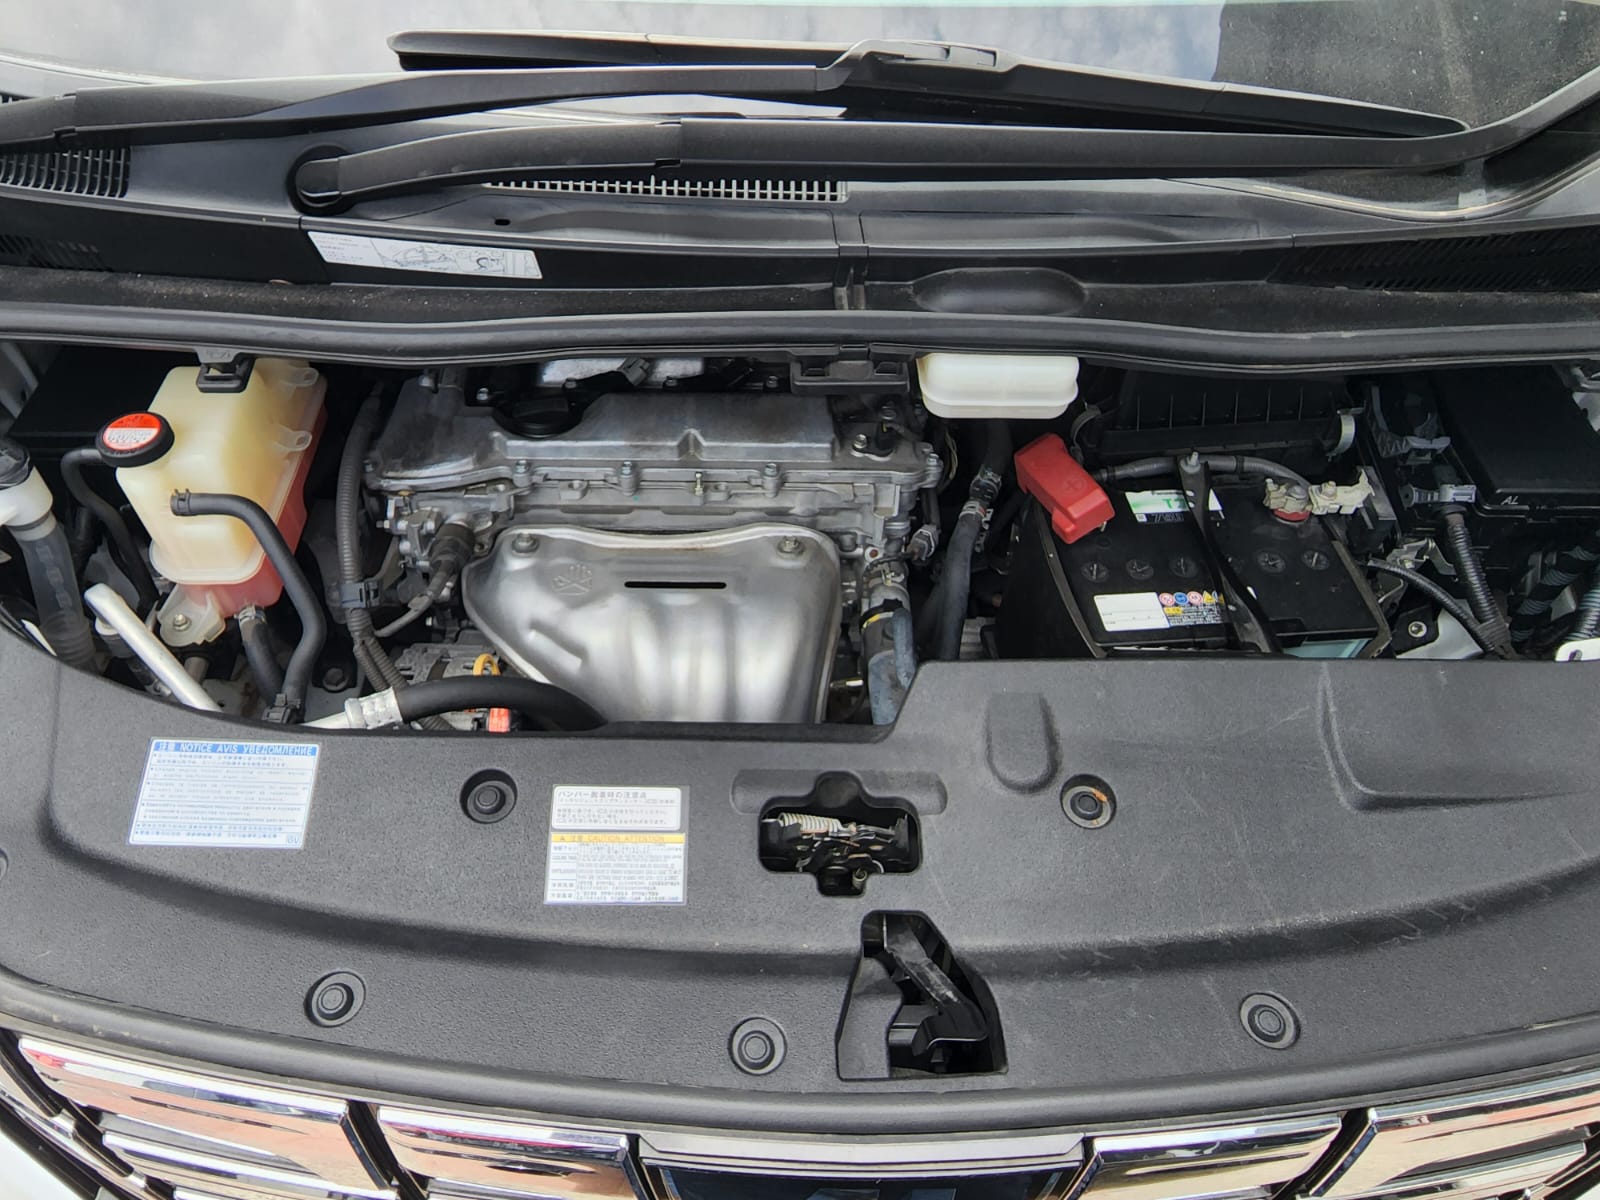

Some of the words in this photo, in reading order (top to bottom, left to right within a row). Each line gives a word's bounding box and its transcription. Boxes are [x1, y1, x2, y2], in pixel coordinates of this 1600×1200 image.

[180, 742, 212, 753] NOTICE
[217, 744, 237, 754] AVIS
[243, 744, 313, 756] УВЕДОМЛЕНИЕ
